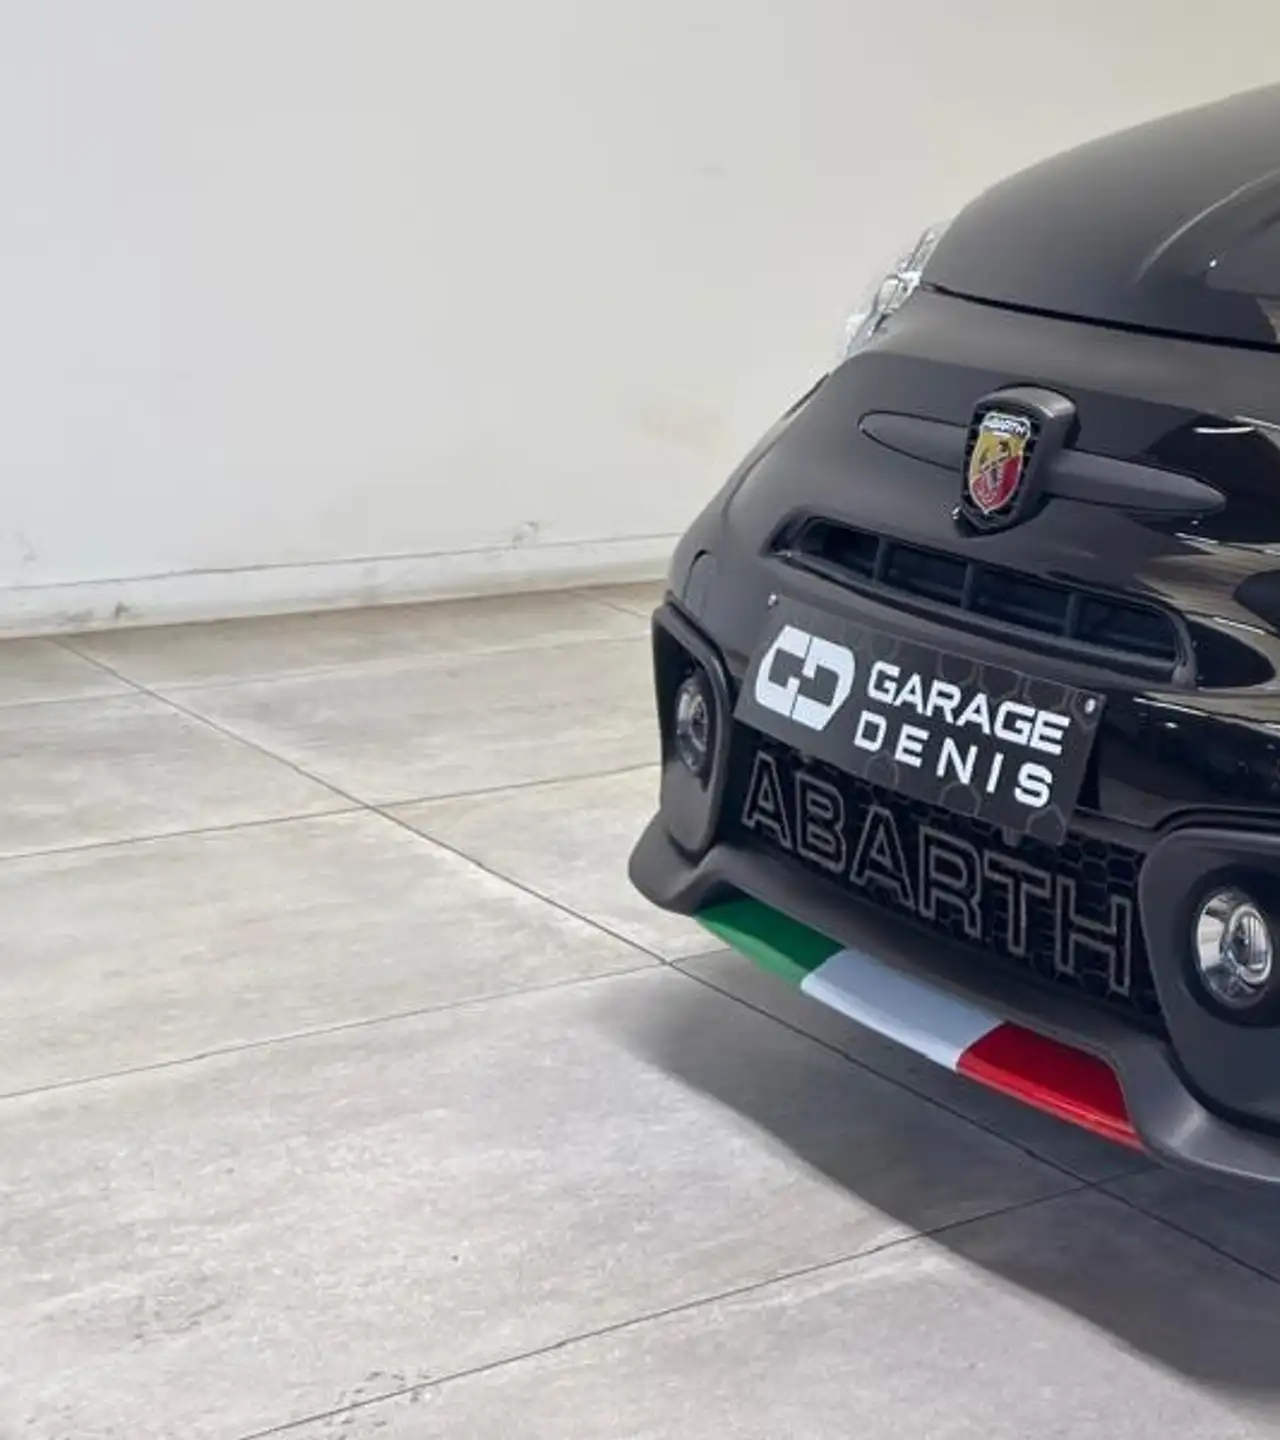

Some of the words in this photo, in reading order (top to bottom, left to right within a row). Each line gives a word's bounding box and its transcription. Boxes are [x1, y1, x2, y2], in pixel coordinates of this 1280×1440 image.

[866, 660, 1070, 756] GARAGE
[853, 710, 1053, 808] DENIS
[741, 750, 1133, 996] ABARTH
